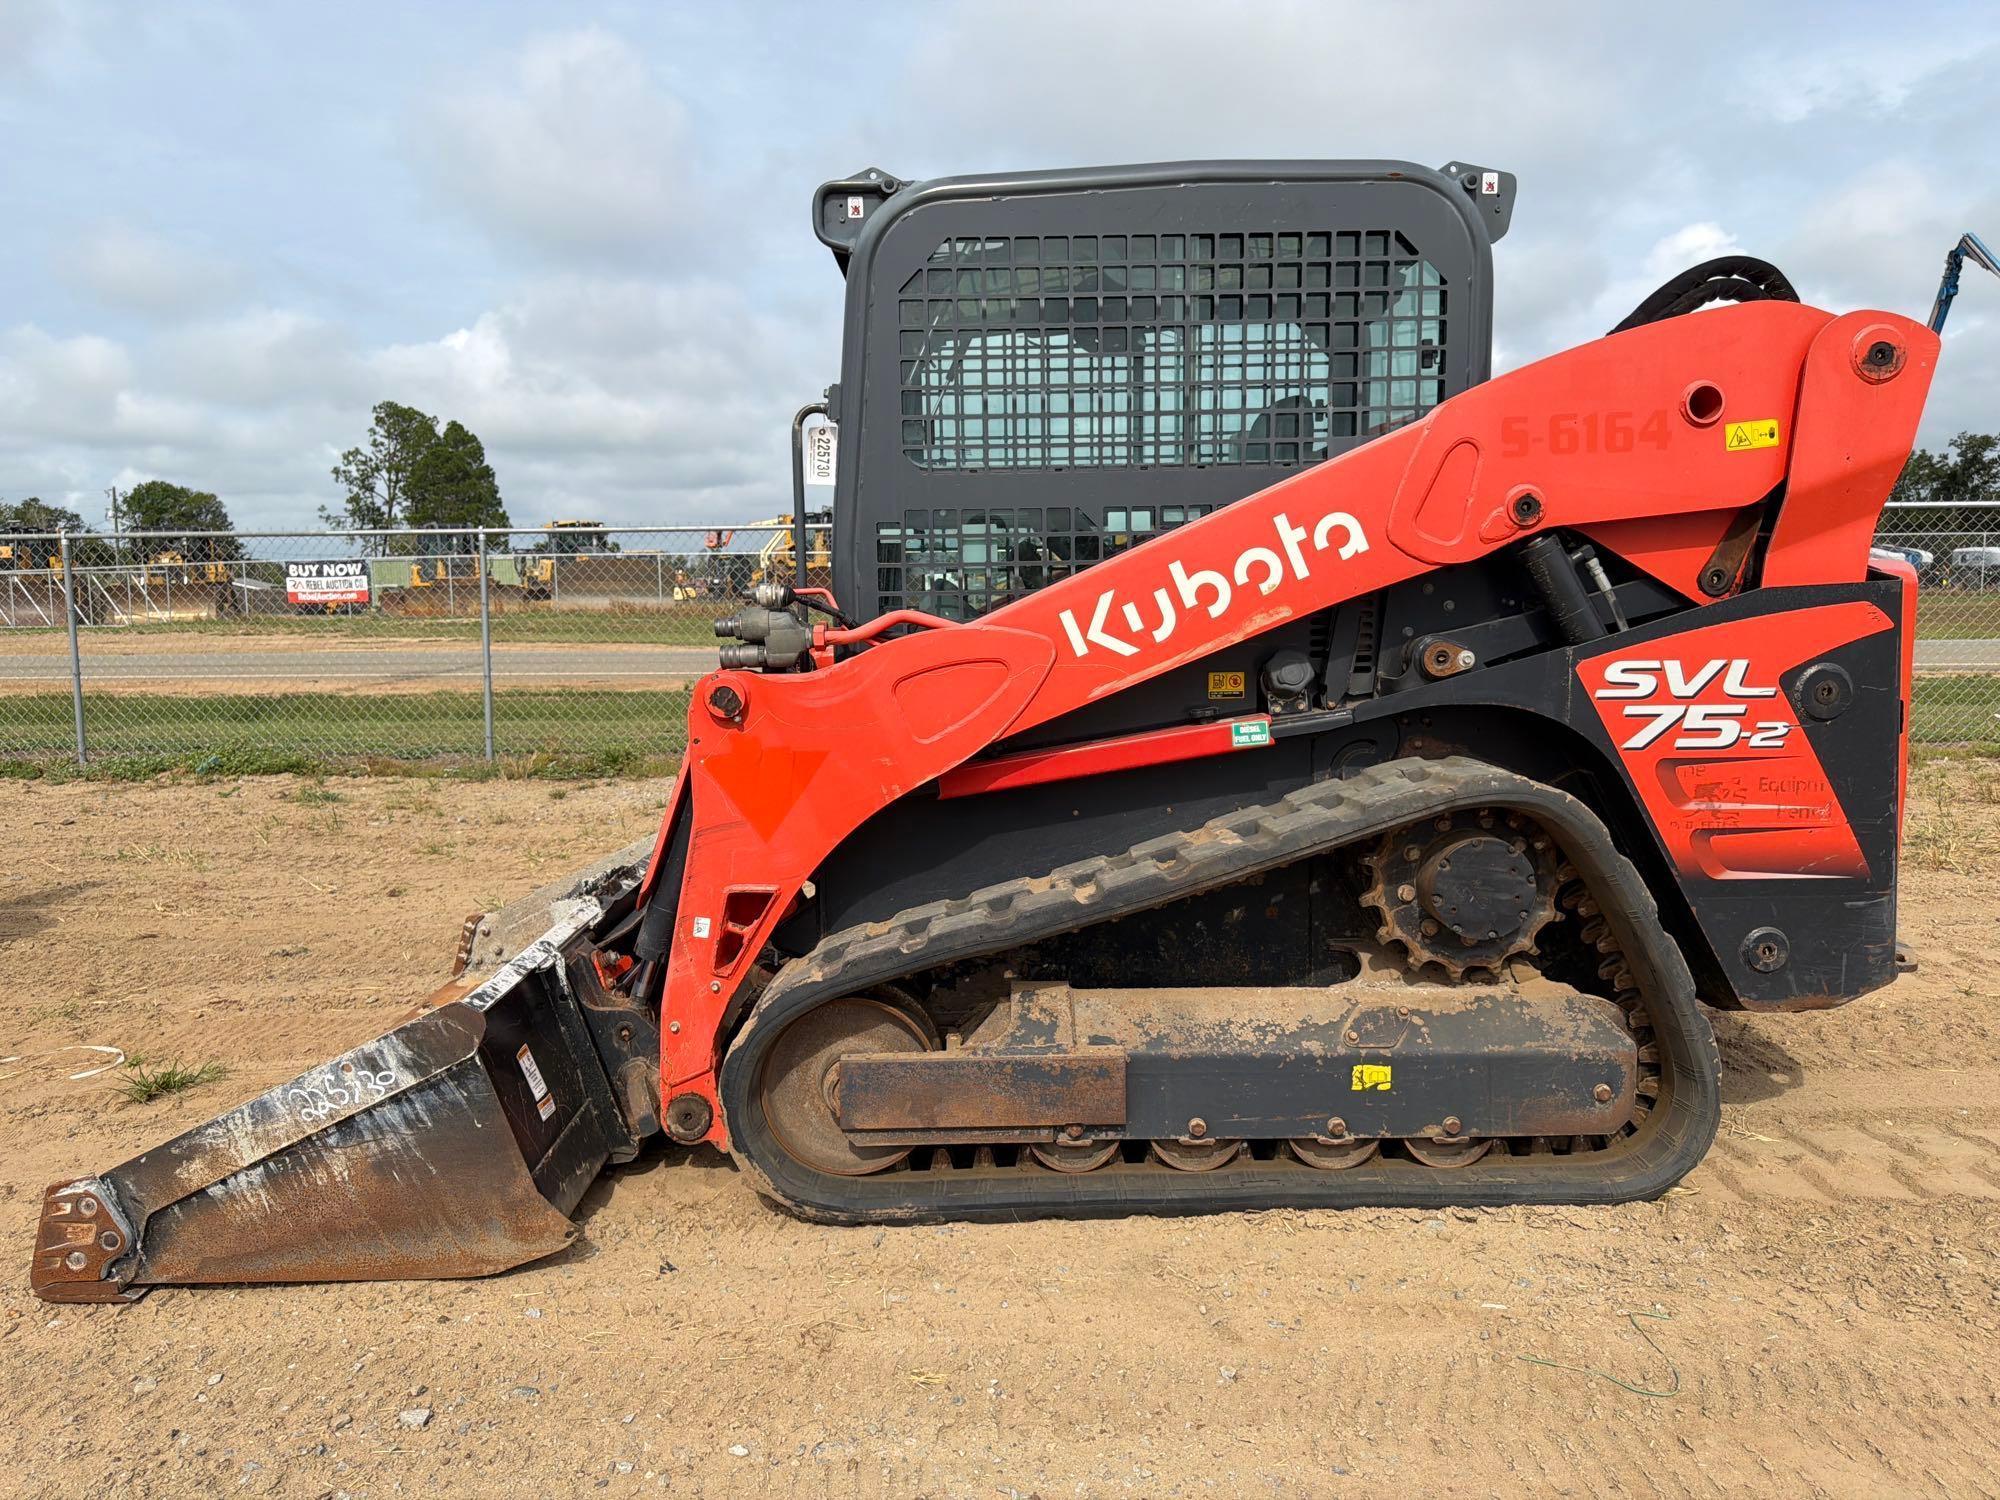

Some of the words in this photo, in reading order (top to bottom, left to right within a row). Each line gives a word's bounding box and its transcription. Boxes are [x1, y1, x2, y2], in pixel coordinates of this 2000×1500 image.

[1501, 410, 1672, 458] S-6164
[817, 438, 831, 477] 225730
[289, 564, 319, 577] BUY
[323, 563, 362, 577] NOW
[306, 580, 324, 590] REBEL
[326, 579, 353, 590] AUCTION
[1058, 511, 1370, 658] Kubota
[1595, 658, 1778, 699] SVL
[1235, 735, 1251, 743] FUEL
[1239, 725, 1261, 734] DIESEL
[1621, 704, 1792, 750] 75-2
[288, 1070, 396, 1121] 225730
